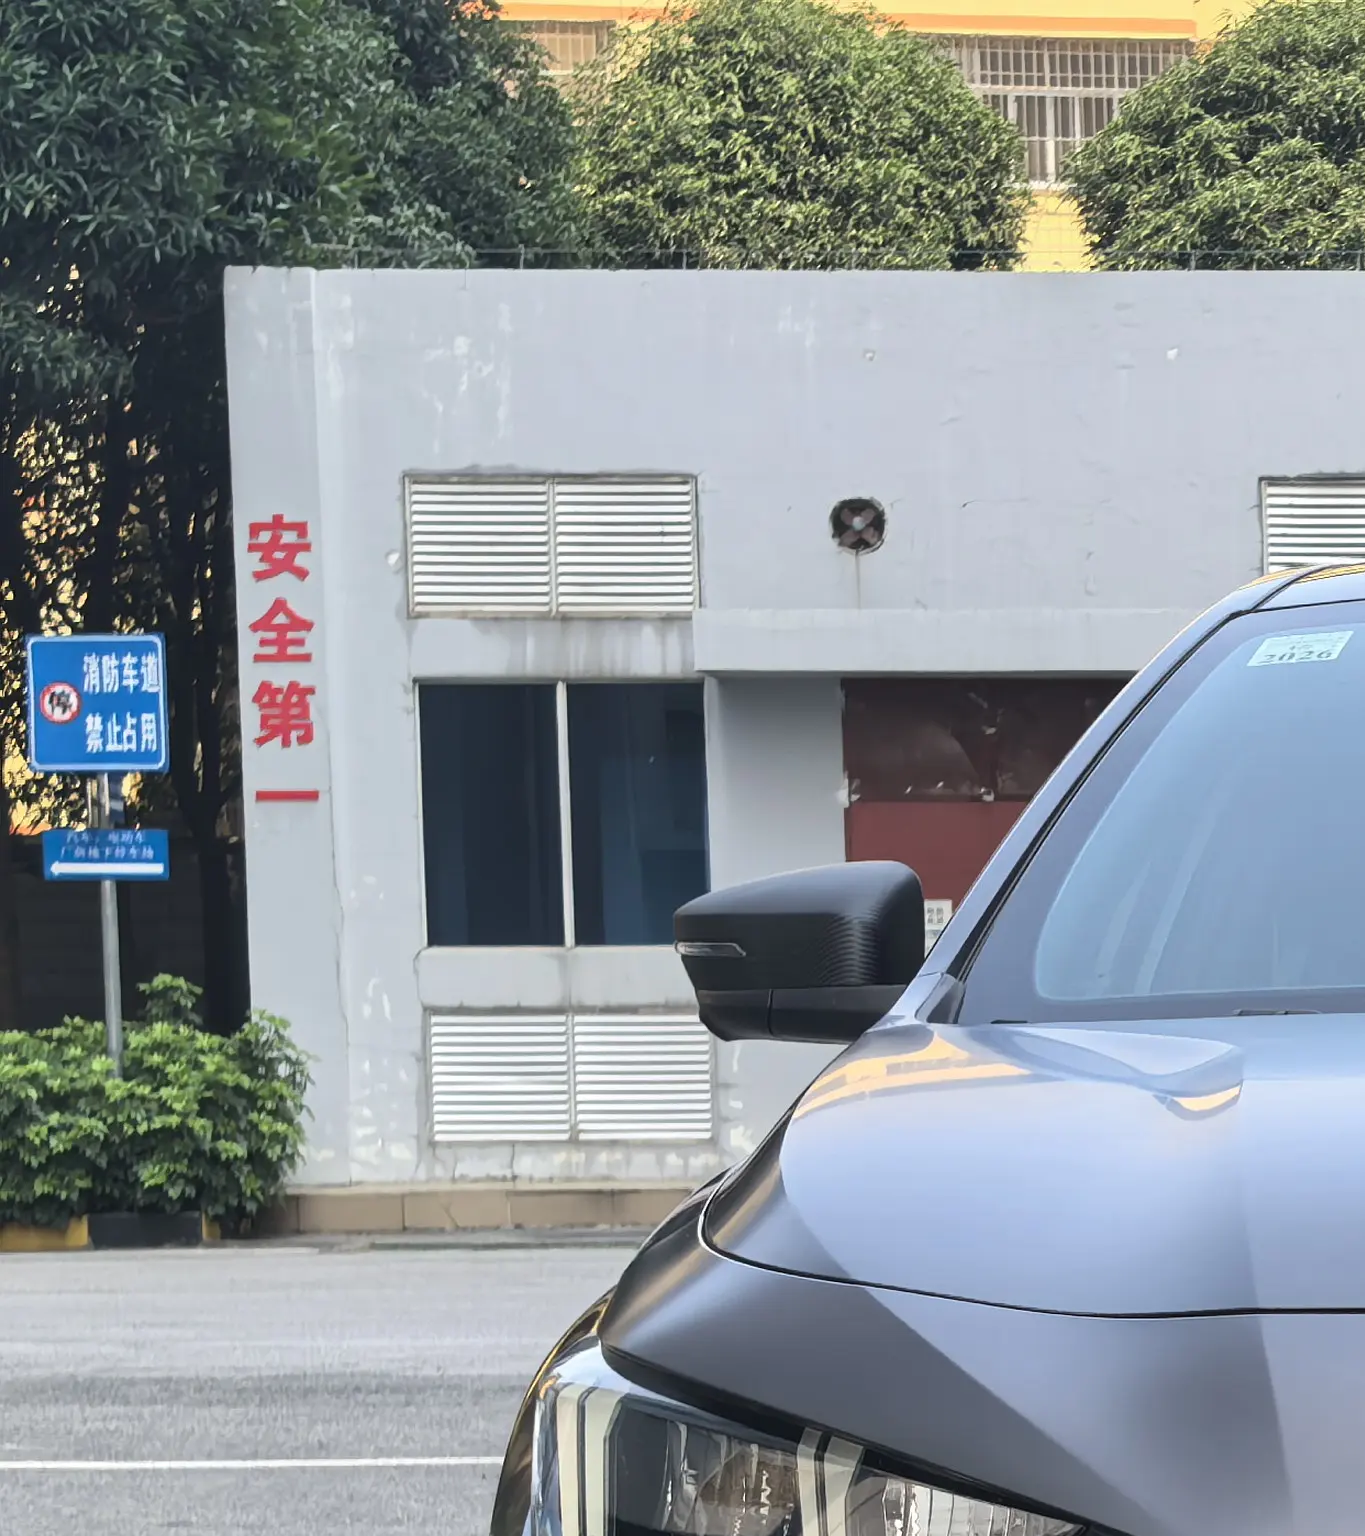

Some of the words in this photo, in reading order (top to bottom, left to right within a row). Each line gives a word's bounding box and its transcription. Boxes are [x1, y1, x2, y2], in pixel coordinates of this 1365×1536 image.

[83, 652, 160, 694] 消防车道
[247, 513, 319, 803] 安全第一
[1257, 650, 1332, 664] 2026
[85, 711, 157, 753] 禁止占用
